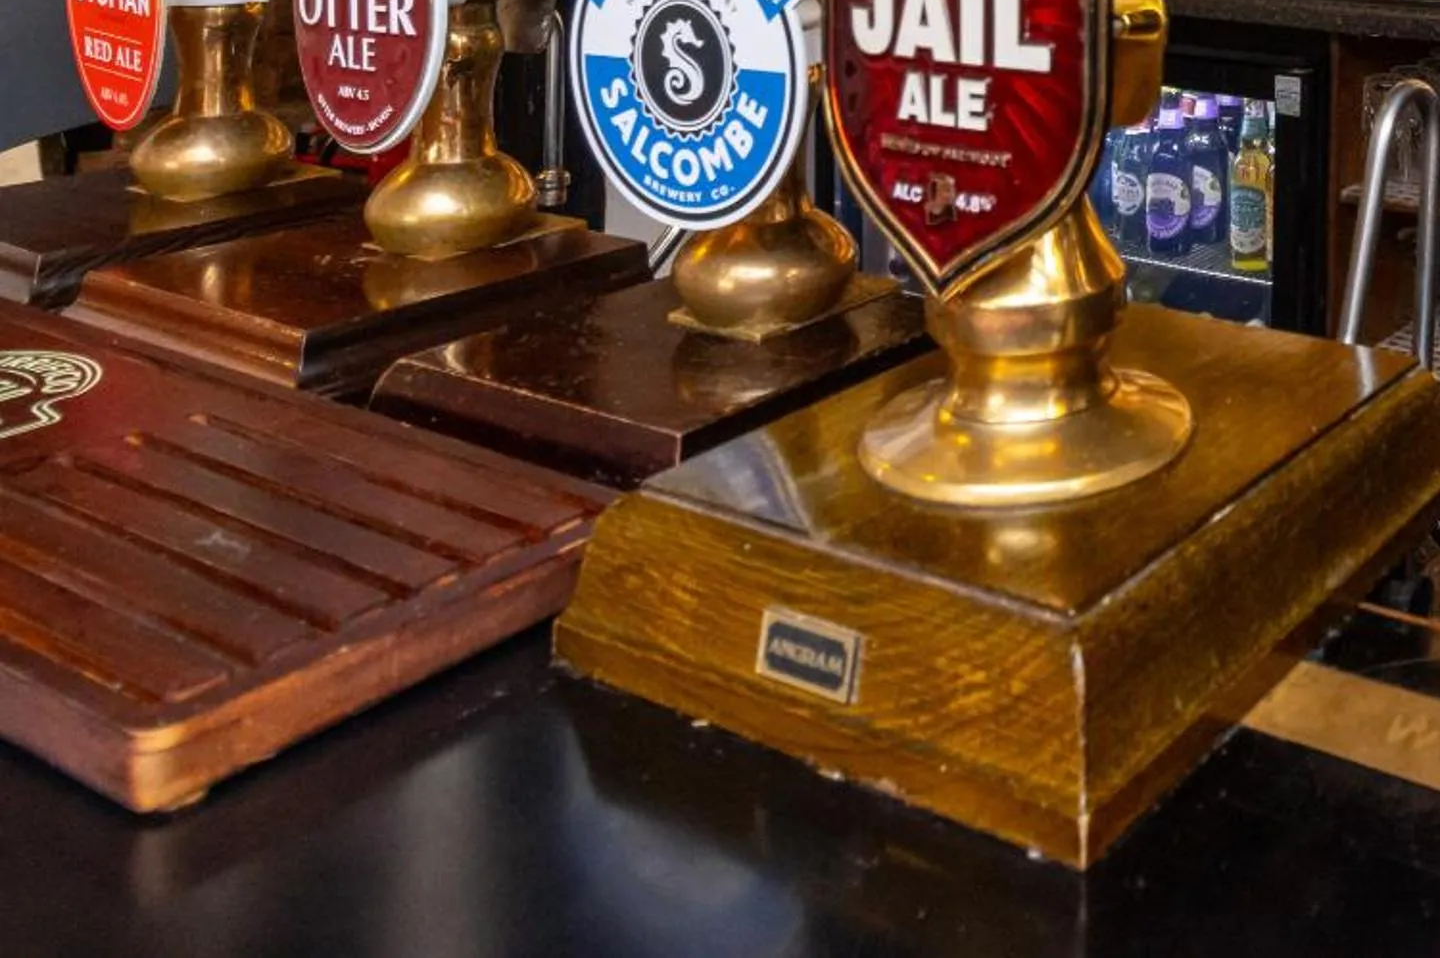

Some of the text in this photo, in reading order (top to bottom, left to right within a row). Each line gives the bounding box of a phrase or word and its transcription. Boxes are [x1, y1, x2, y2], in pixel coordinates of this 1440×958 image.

[83, 35, 144, 72] RED ALE
[329, 37, 377, 73] ALE
[897, 71, 991, 132] ALE
[601, 78, 769, 188] SALCOMBE
[643, 174, 702, 202] BREWERY
[893, 181, 923, 203] ALC
